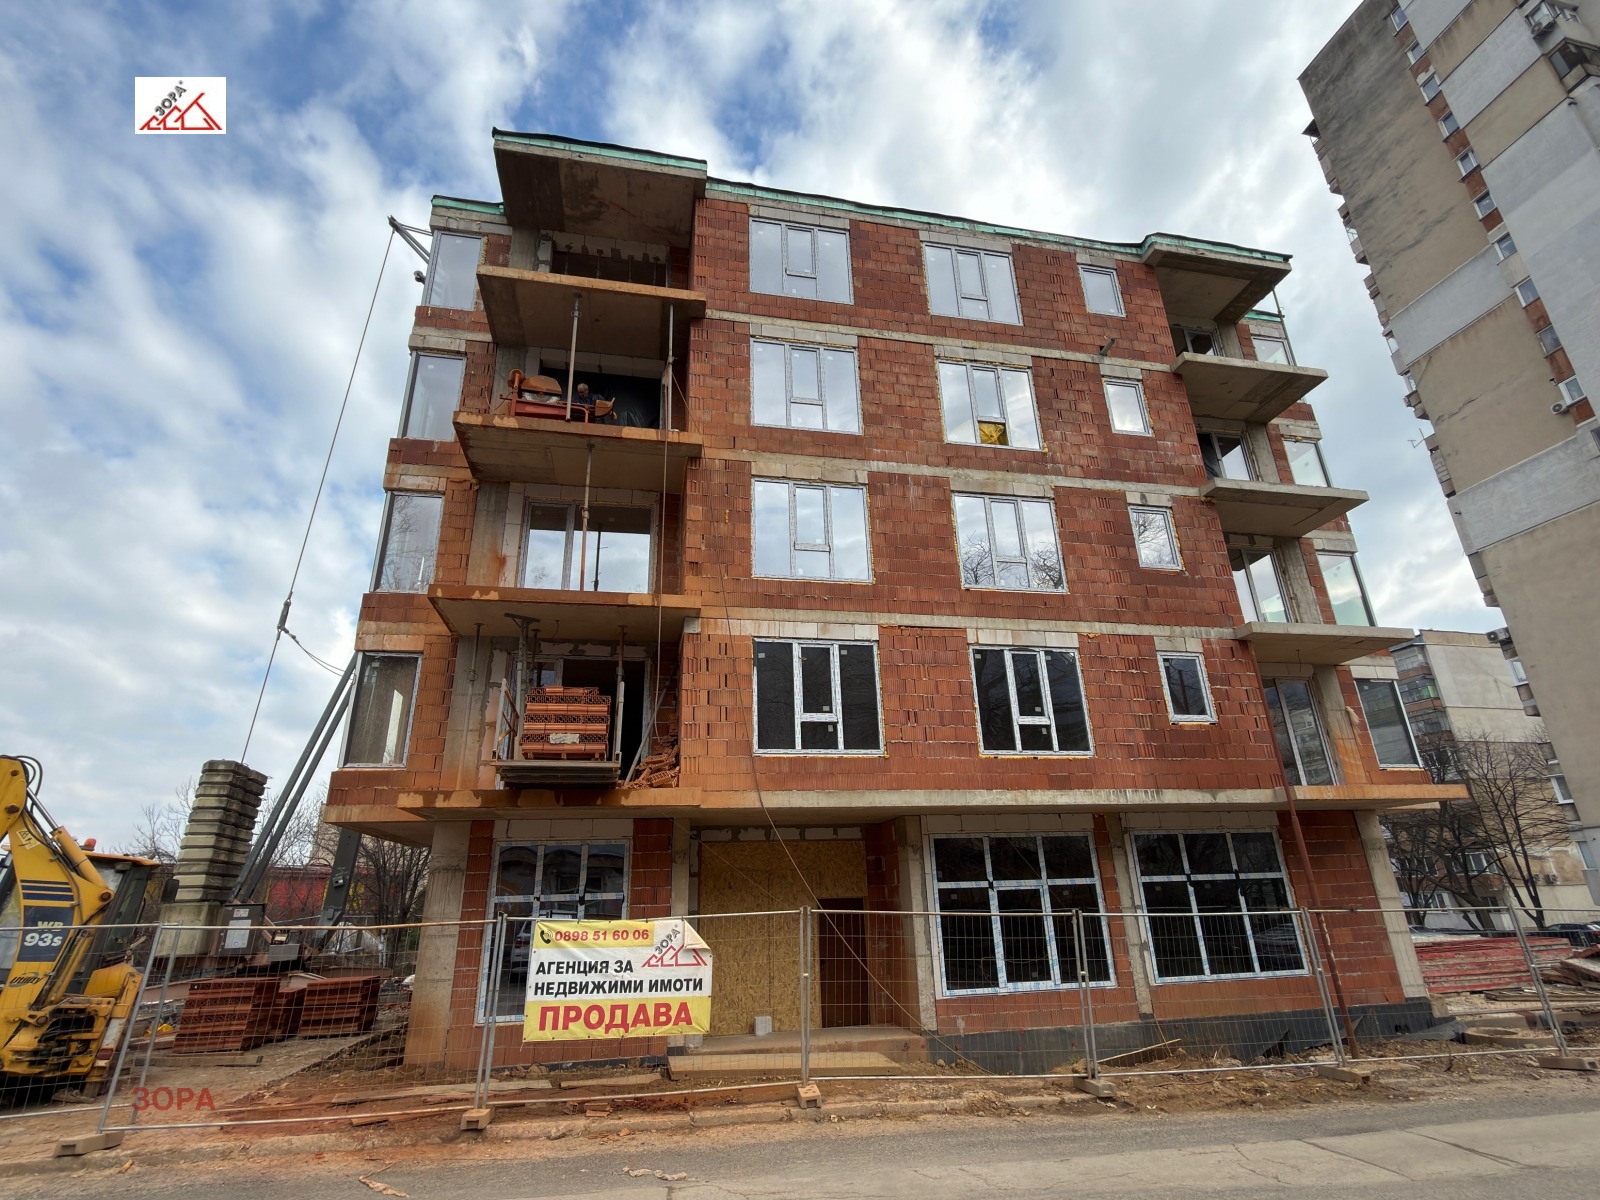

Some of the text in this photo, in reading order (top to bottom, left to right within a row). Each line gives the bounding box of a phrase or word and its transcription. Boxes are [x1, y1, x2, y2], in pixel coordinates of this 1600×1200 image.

[23, 932, 63, 947] 93s
[554, 929, 650, 942] 0898 51 60 06
[655, 928, 681, 955] ЗОРА
[535, 960, 634, 976] АГЕНЦИЯ ЗА
[534, 978, 703, 998] НЕДВИЖИМИ ИМОТИ
[538, 1001, 693, 1034] ПРОДАВА
